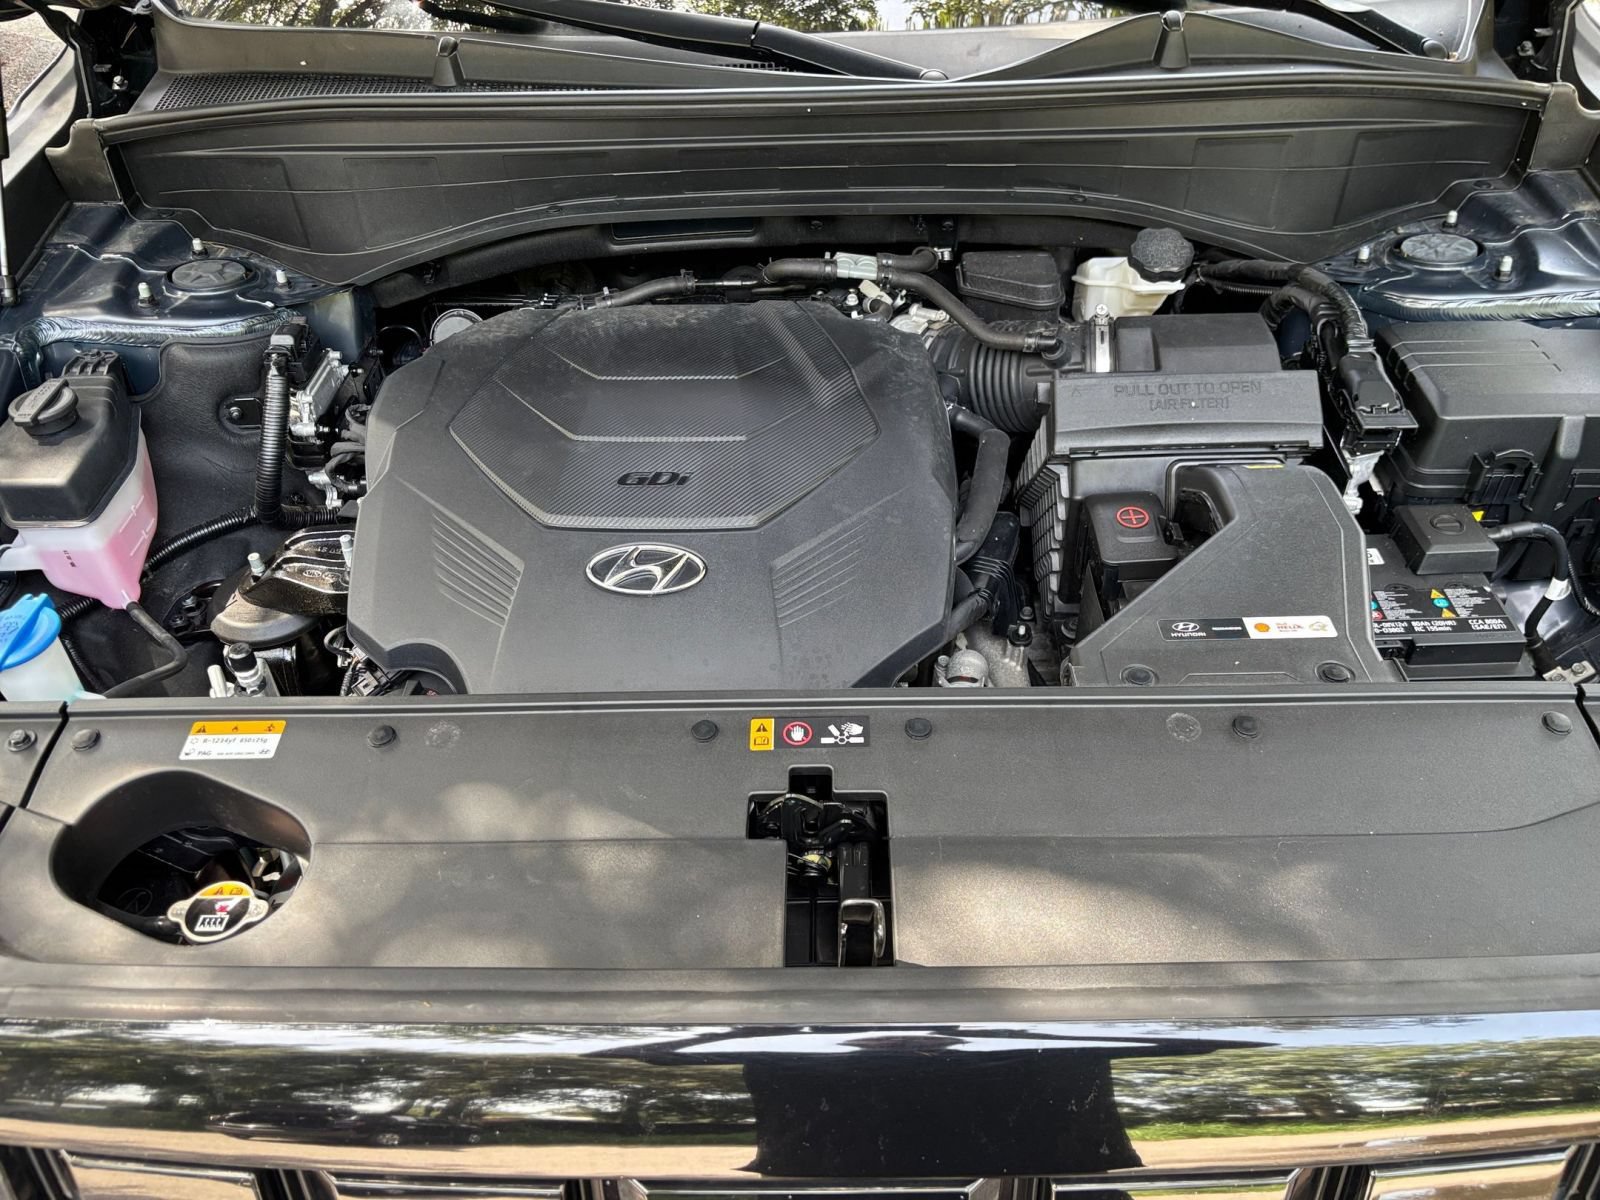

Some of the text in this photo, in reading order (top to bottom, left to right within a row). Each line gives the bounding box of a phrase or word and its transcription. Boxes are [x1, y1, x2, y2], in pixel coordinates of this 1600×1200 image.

[1114, 381, 1262, 397] PULL OUT TO OPEN
